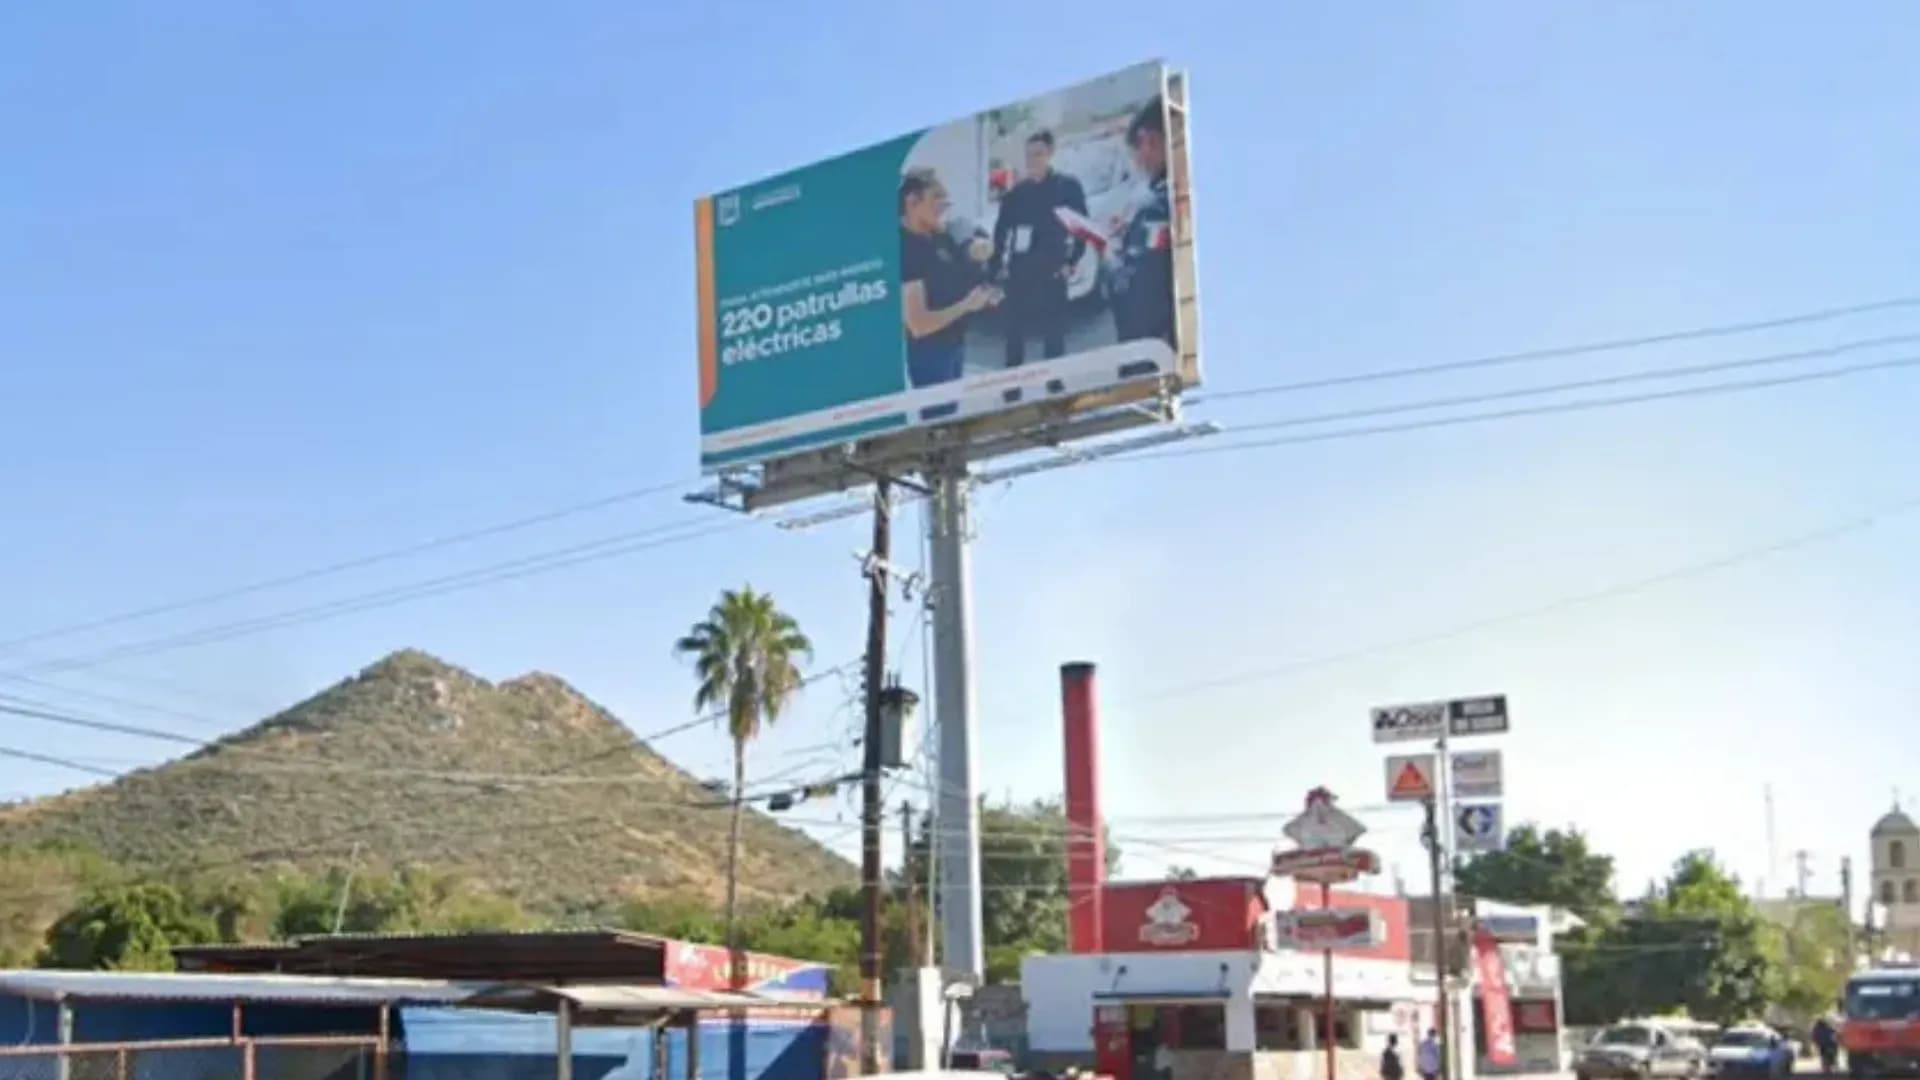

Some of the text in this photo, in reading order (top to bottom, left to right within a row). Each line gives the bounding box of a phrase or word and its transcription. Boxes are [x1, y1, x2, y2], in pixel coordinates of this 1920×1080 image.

[722, 304, 772, 337] 220
[776, 280, 888, 329] patrullas
[722, 319, 842, 366] eléctricas
